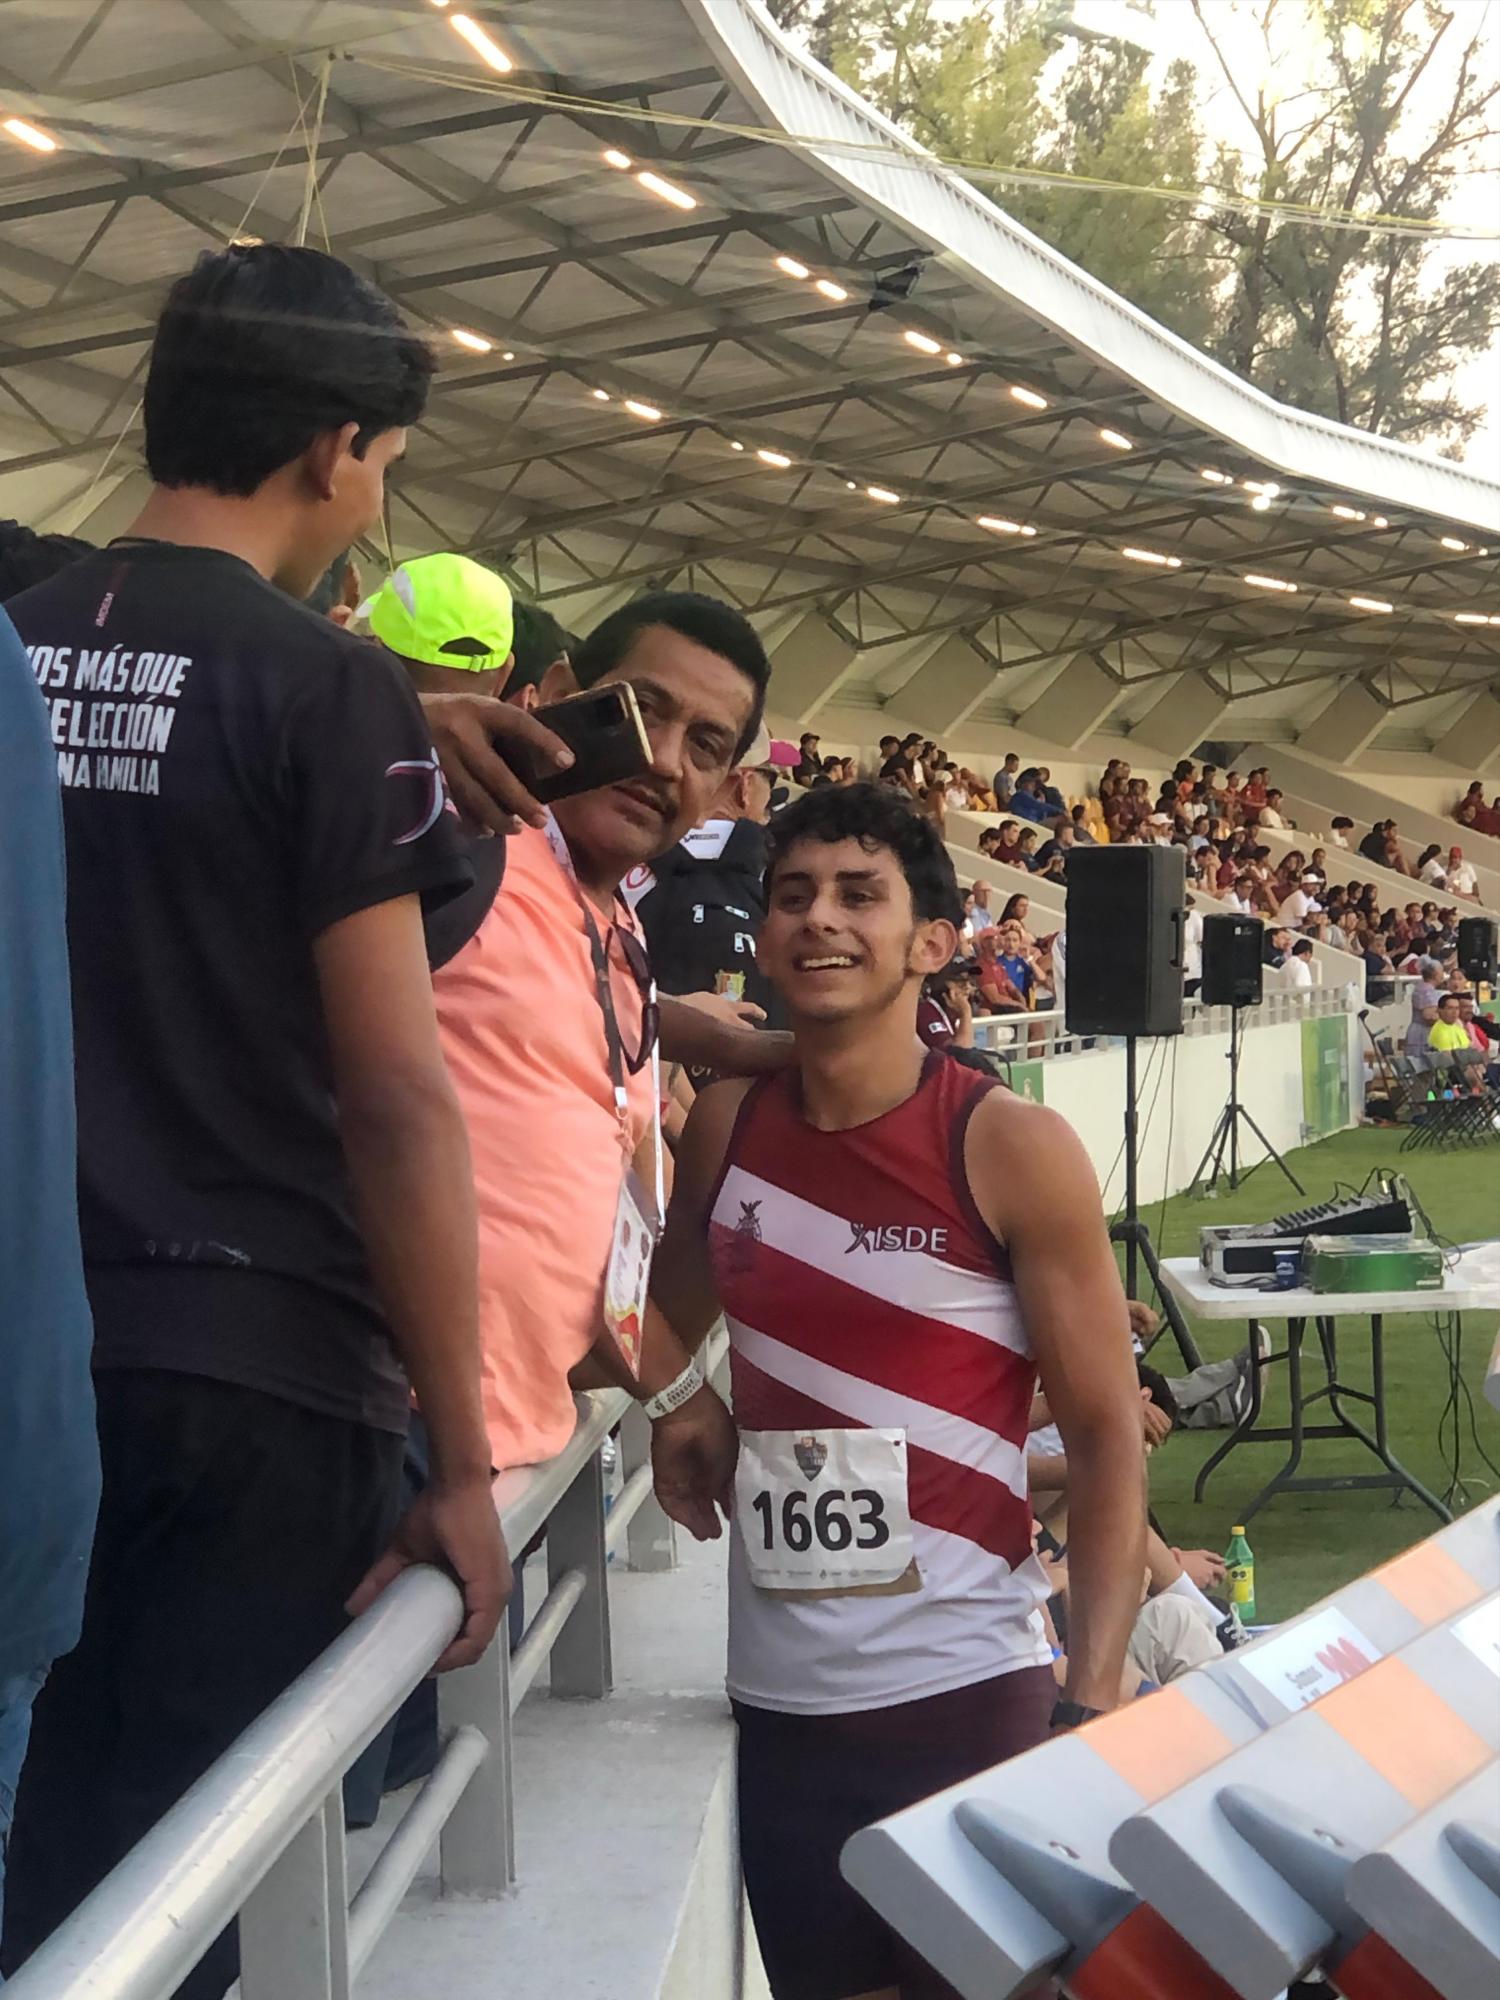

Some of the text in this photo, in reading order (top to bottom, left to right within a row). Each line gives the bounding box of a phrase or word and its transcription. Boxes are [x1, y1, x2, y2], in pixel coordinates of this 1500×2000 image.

[74, 643, 134, 692] MÁS
[131, 652, 192, 697] QUE
[45, 695, 176, 752] ELECCIÓN
[752, 1489, 890, 1552] 1663
